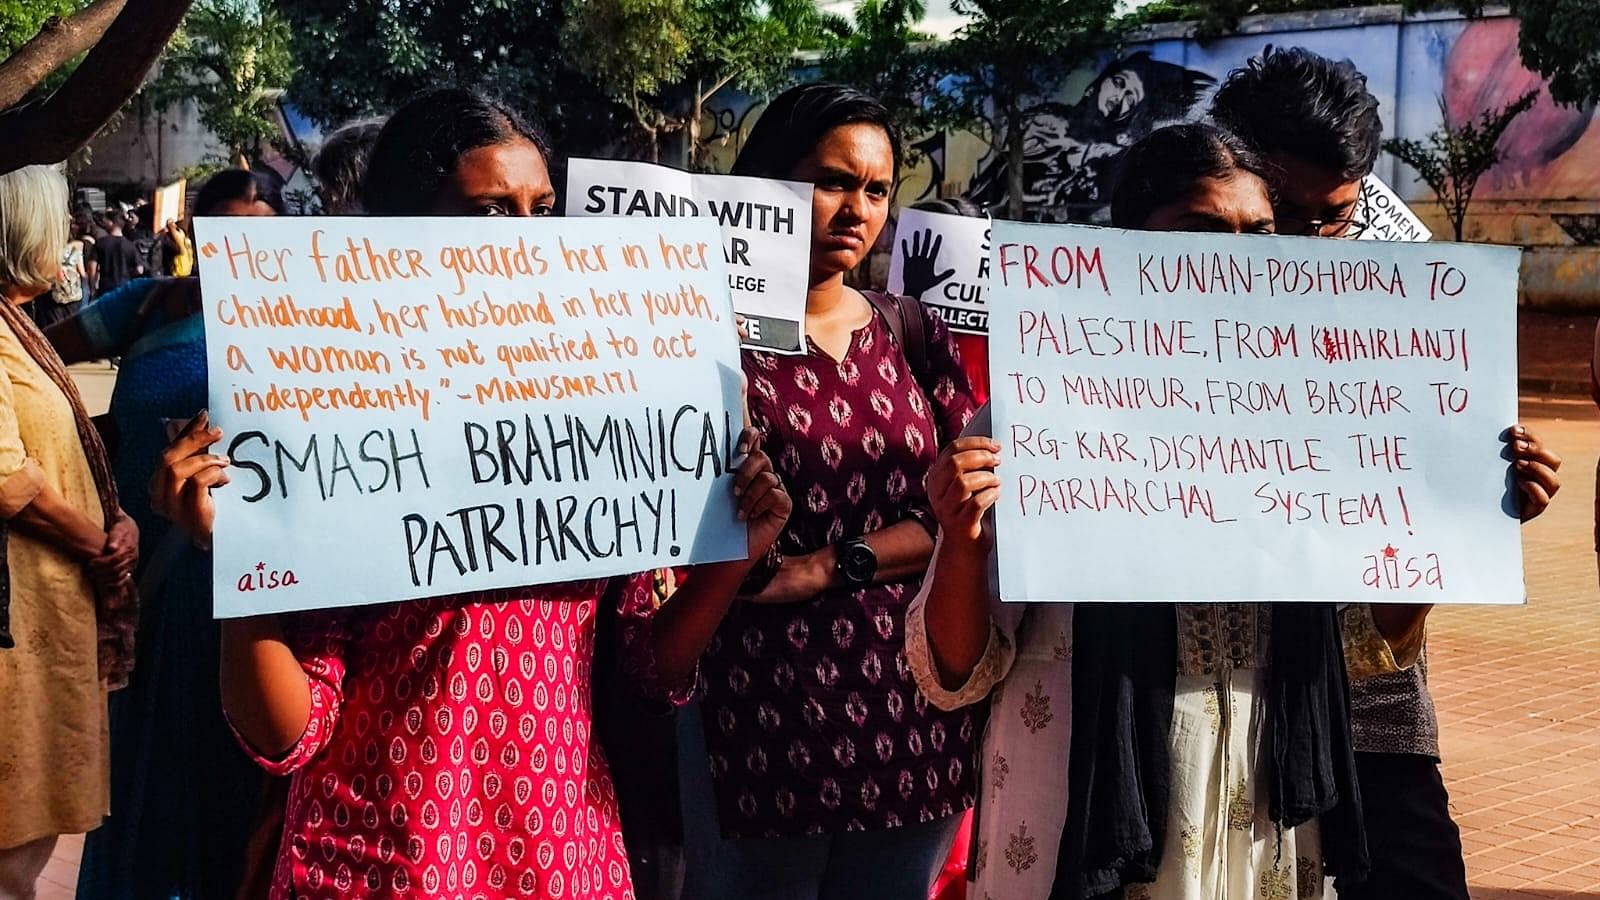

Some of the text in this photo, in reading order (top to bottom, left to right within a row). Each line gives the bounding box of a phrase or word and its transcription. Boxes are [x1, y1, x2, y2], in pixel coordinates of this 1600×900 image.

[584, 185, 794, 235] STAND WITH
[559, 235, 609, 273] her
[619, 237, 649, 270] in
[658, 233, 708, 271] her
[999, 243, 1112, 297] FROM
[1138, 252, 1407, 298] KUNAN-POSHPORA
[1426, 261, 1467, 301] TO
[437, 290, 556, 327] husband
[560, 294, 586, 318] in
[589, 287, 633, 318] her
[728, 274, 766, 293] LEGE
[944, 282, 989, 304] CUL
[226, 326, 697, 377] a woman is not qualified to act
[1018, 310, 1209, 358] PALESTINE,
[1214, 318, 1300, 364] FROM
[1008, 371, 1046, 404] TO
[1206, 377, 1292, 415] FROM
[1305, 378, 1412, 420] BASTAR
[1429, 382, 1469, 416] TO
[226, 404, 740, 503] SMASH BRAHMINICAL
[1149, 434, 1331, 476] DISMANTLE
[1348, 433, 1413, 473] THE
[1018, 474, 1414, 536] PATRIARCHAL SYSTEM!
[401, 488, 681, 587] PATRIARCHY!
[237, 561, 299, 592] aisa
